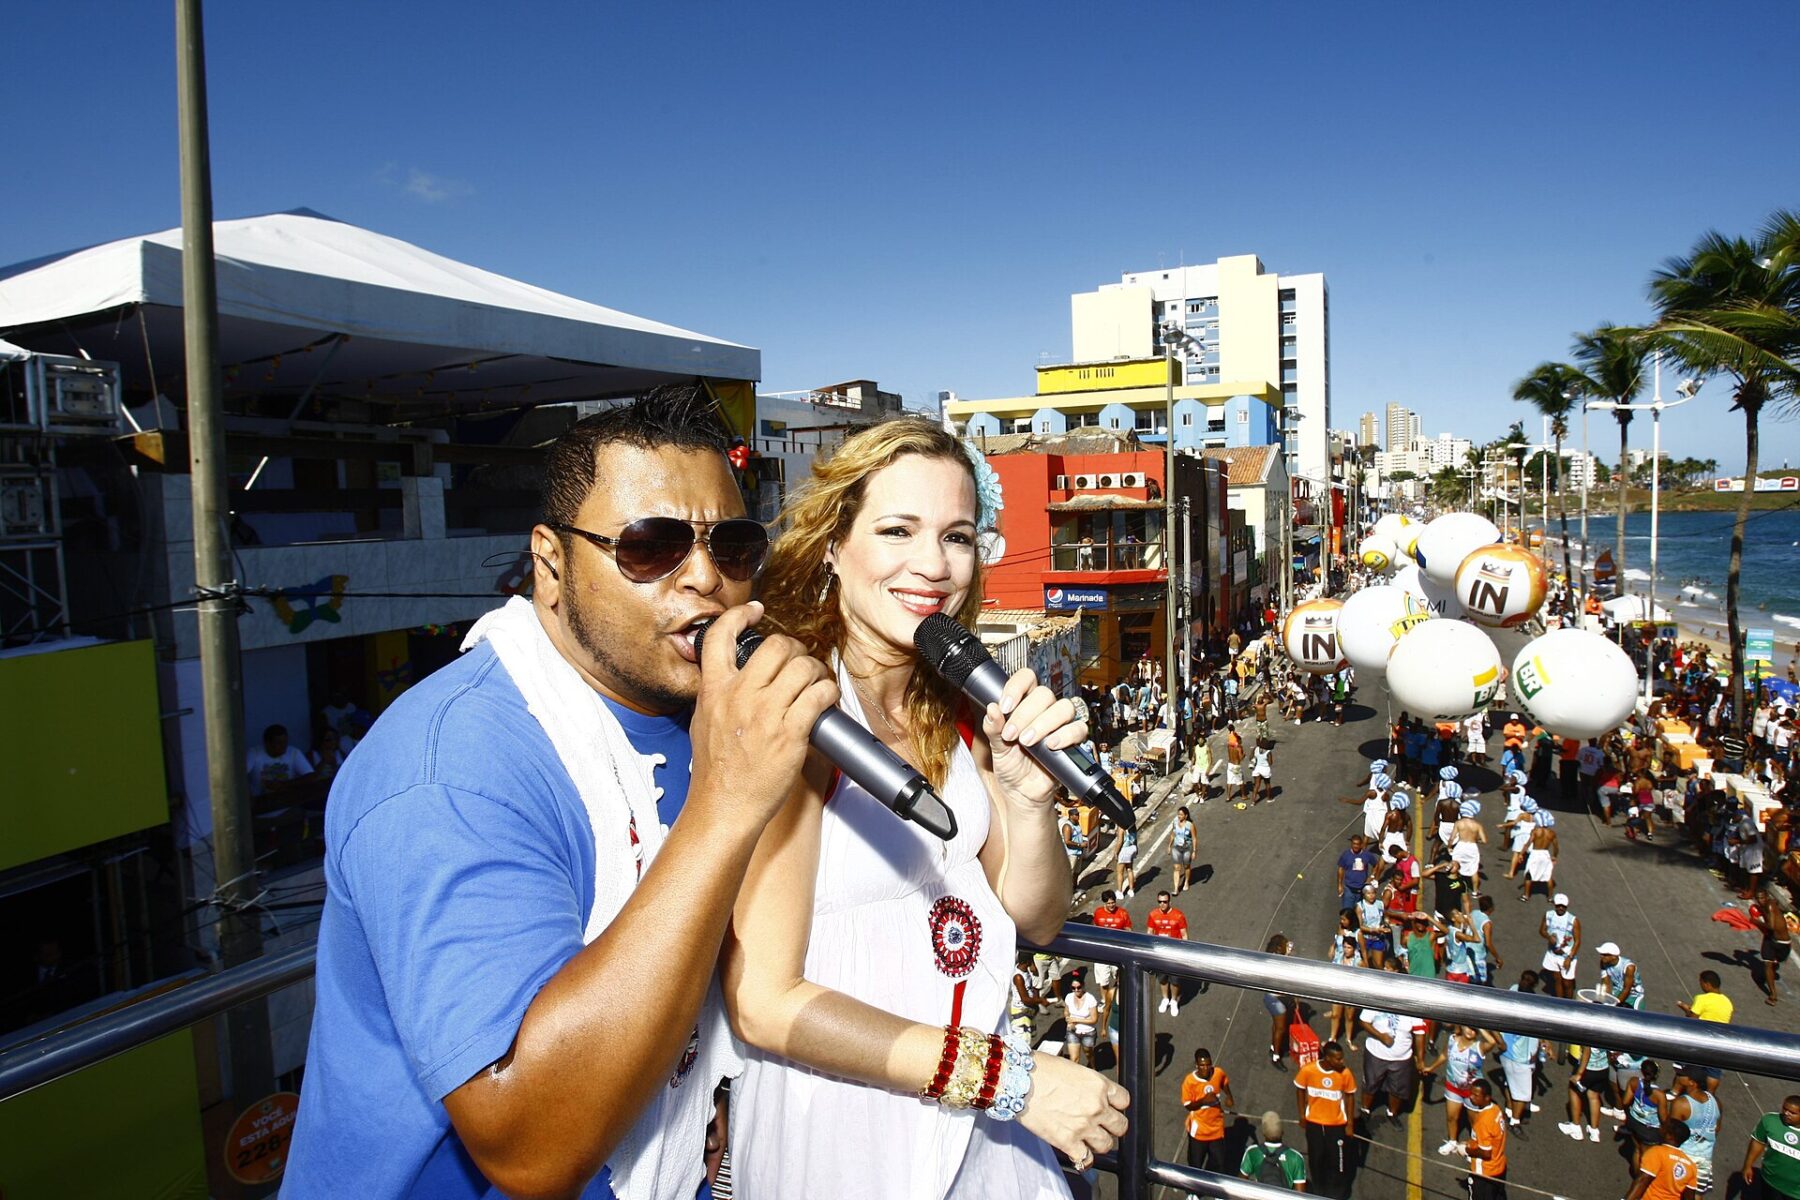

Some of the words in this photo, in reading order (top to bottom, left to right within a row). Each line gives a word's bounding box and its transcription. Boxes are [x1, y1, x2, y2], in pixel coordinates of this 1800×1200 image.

[1468, 579, 1509, 615] IN
[1302, 633, 1336, 661] IN
[1519, 662, 1541, 694] BR
[252, 1106, 283, 1128] VOCÊ
[271, 1110, 297, 1131] AQU
